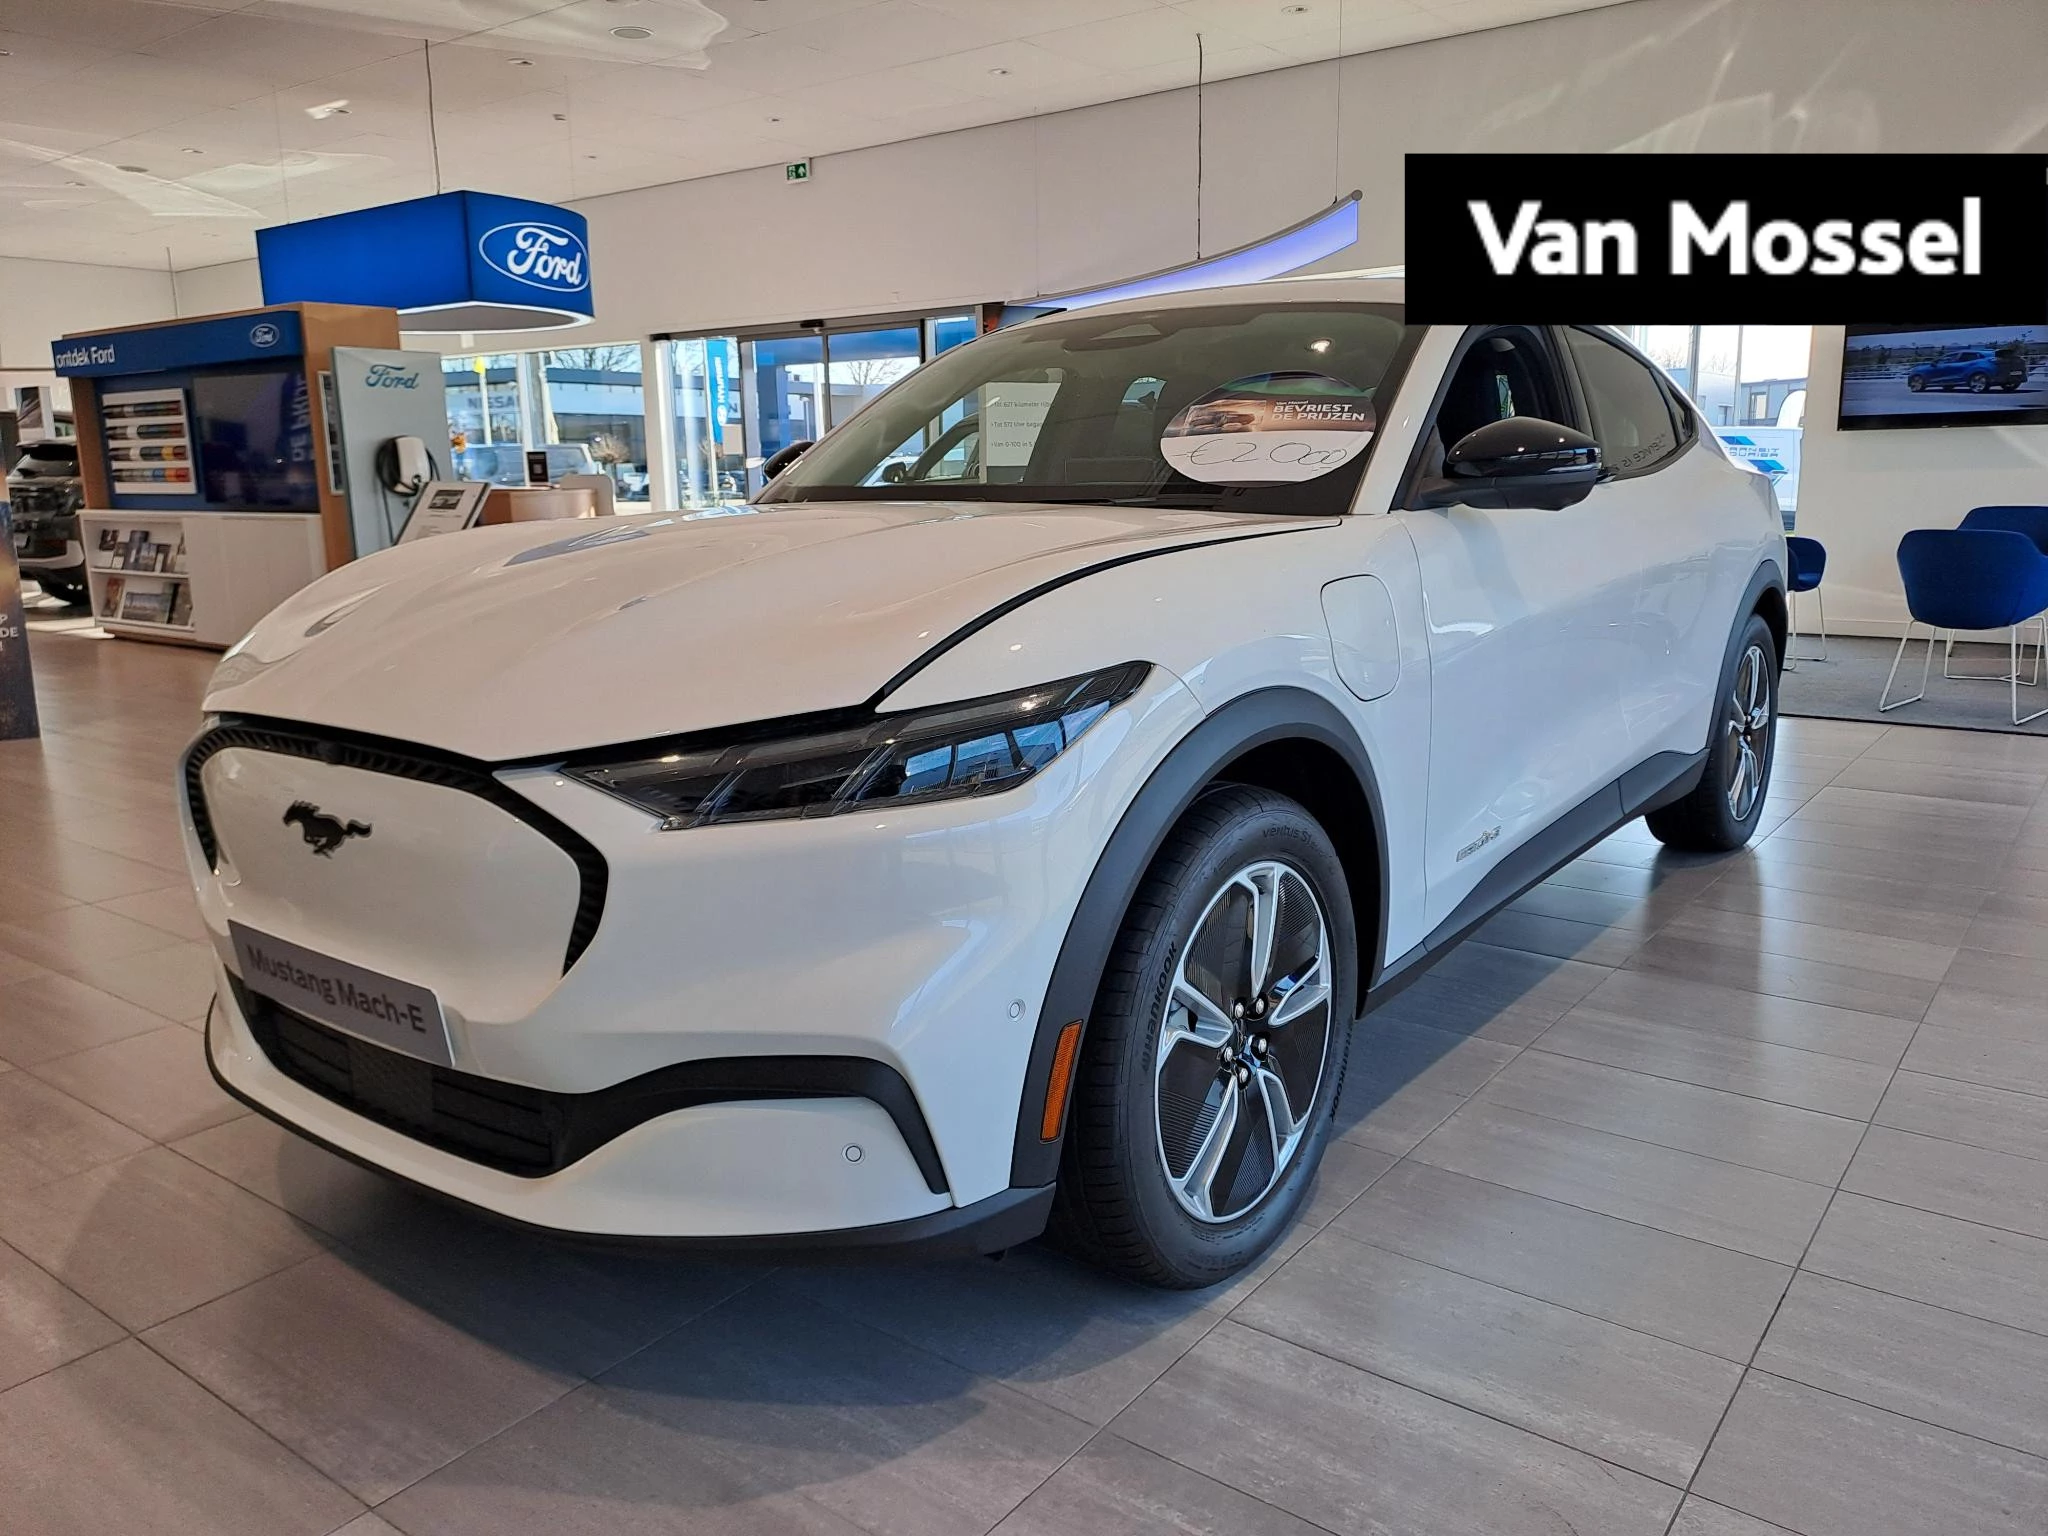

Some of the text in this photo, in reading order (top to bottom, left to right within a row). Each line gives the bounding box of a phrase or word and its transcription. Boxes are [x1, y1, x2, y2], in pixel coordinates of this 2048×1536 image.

[507, 227, 582, 285] Ford
[56, 343, 115, 368] ontdek Ford
[365, 364, 420, 389] Ford
[1272, 413, 1365, 421] DE PRIJZEN
[1273, 404, 1352, 413] BEVRIEST
[247, 945, 427, 1035] Mustang Mach-E
